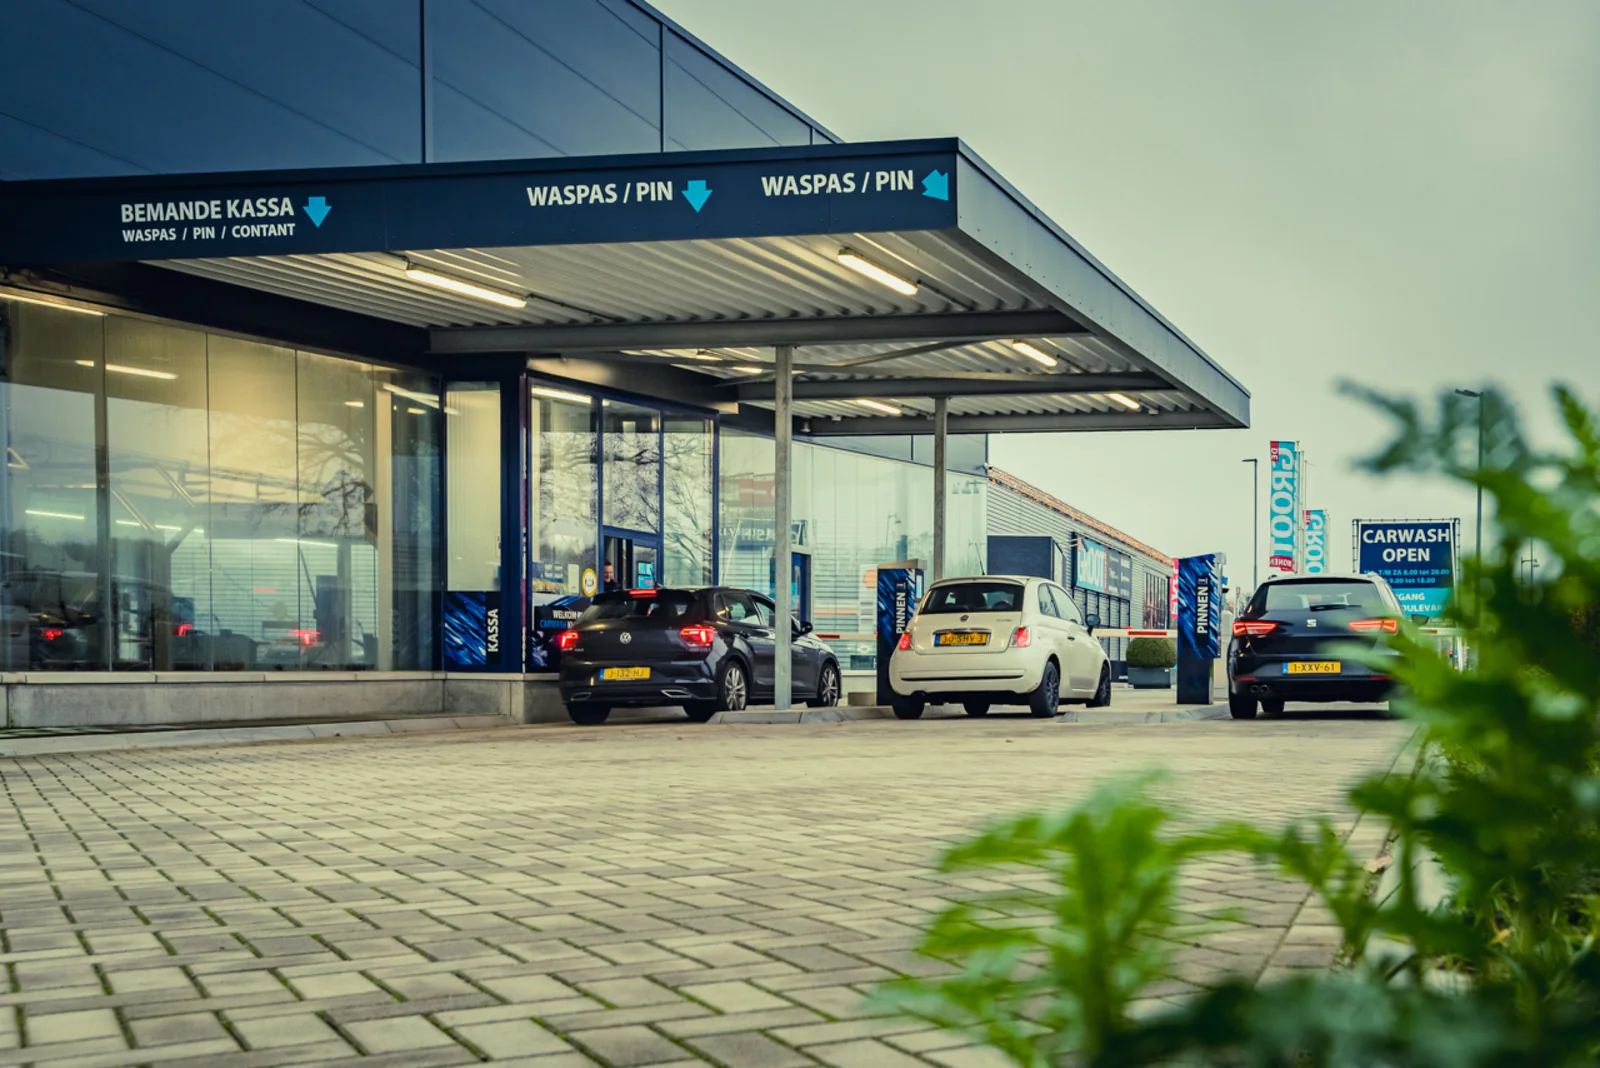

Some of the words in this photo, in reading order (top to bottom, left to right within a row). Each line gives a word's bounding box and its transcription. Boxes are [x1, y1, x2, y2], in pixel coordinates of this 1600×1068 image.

[526, 183, 618, 207] WASPAS
[623, 182, 631, 204] /
[636, 180, 673, 202] PIN
[761, 172, 856, 197] WASPAS
[861, 171, 870, 194] /
[875, 169, 914, 192] PIN
[121, 200, 222, 223] BEMANDE
[226, 197, 294, 218] KASSA
[122, 227, 177, 242] WASPAS
[182, 227, 187, 241] /
[193, 226, 215, 240] PIN
[221, 225, 226, 239] /
[231, 223, 296, 238] CONTANT
[1362, 528, 1450, 543] CARWASH
[1382, 548, 1430, 562] OPEN
[1397, 592, 1425, 601] GANG
[896, 592, 906, 634] PINNEN
[1196, 586, 1209, 634] PINNEN
[487, 608, 499, 652] KASSA
[1293, 663, 1335, 672] 1-XXV-61
